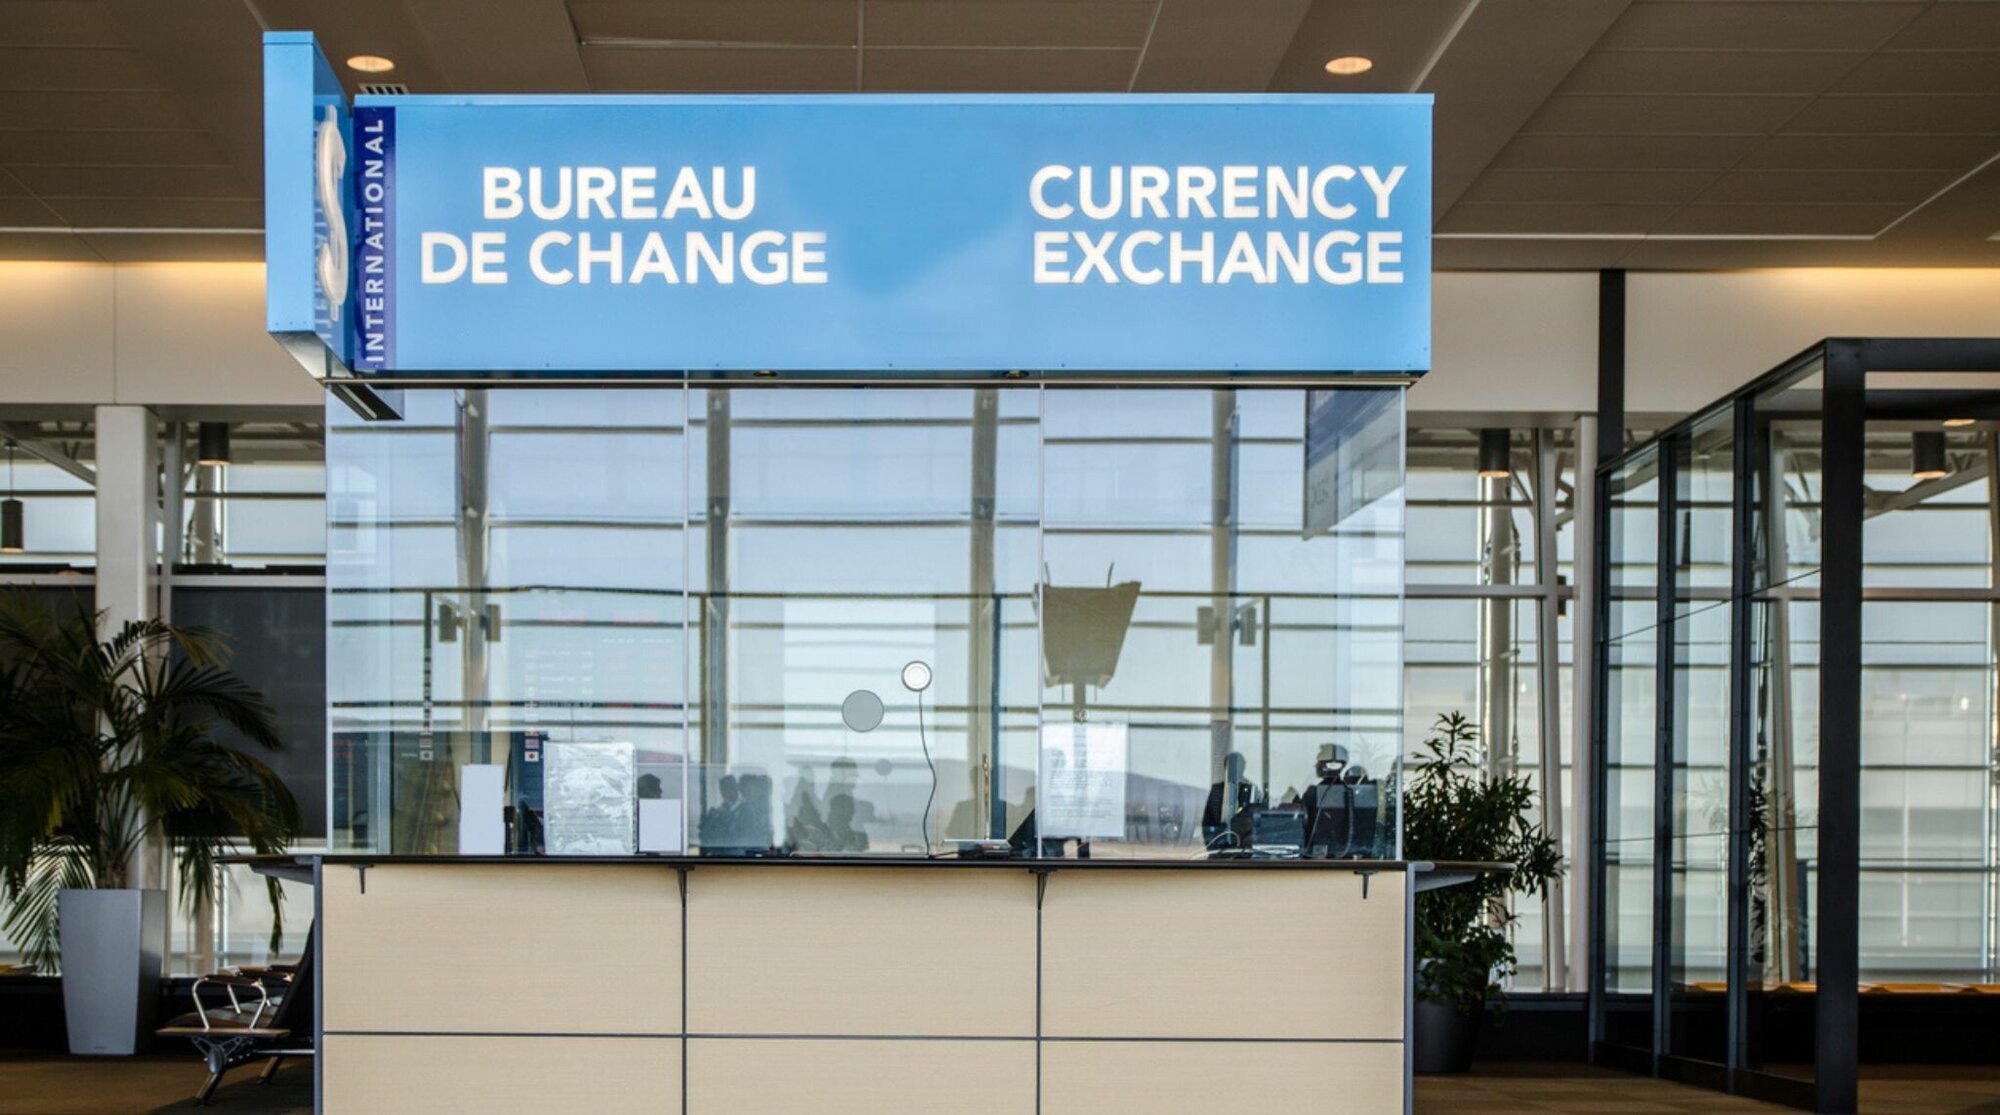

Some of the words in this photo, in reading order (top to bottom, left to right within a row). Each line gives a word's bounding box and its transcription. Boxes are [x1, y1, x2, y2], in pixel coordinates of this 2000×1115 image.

[482, 165, 757, 221] BUREAU
[1029, 164, 1407, 221] CURRENCY
[364, 119, 385, 362] INTERNATIONAL
[420, 231, 508, 284] DE
[528, 230, 829, 285] CHANGE
[1033, 230, 1404, 285] EXCHANGE
